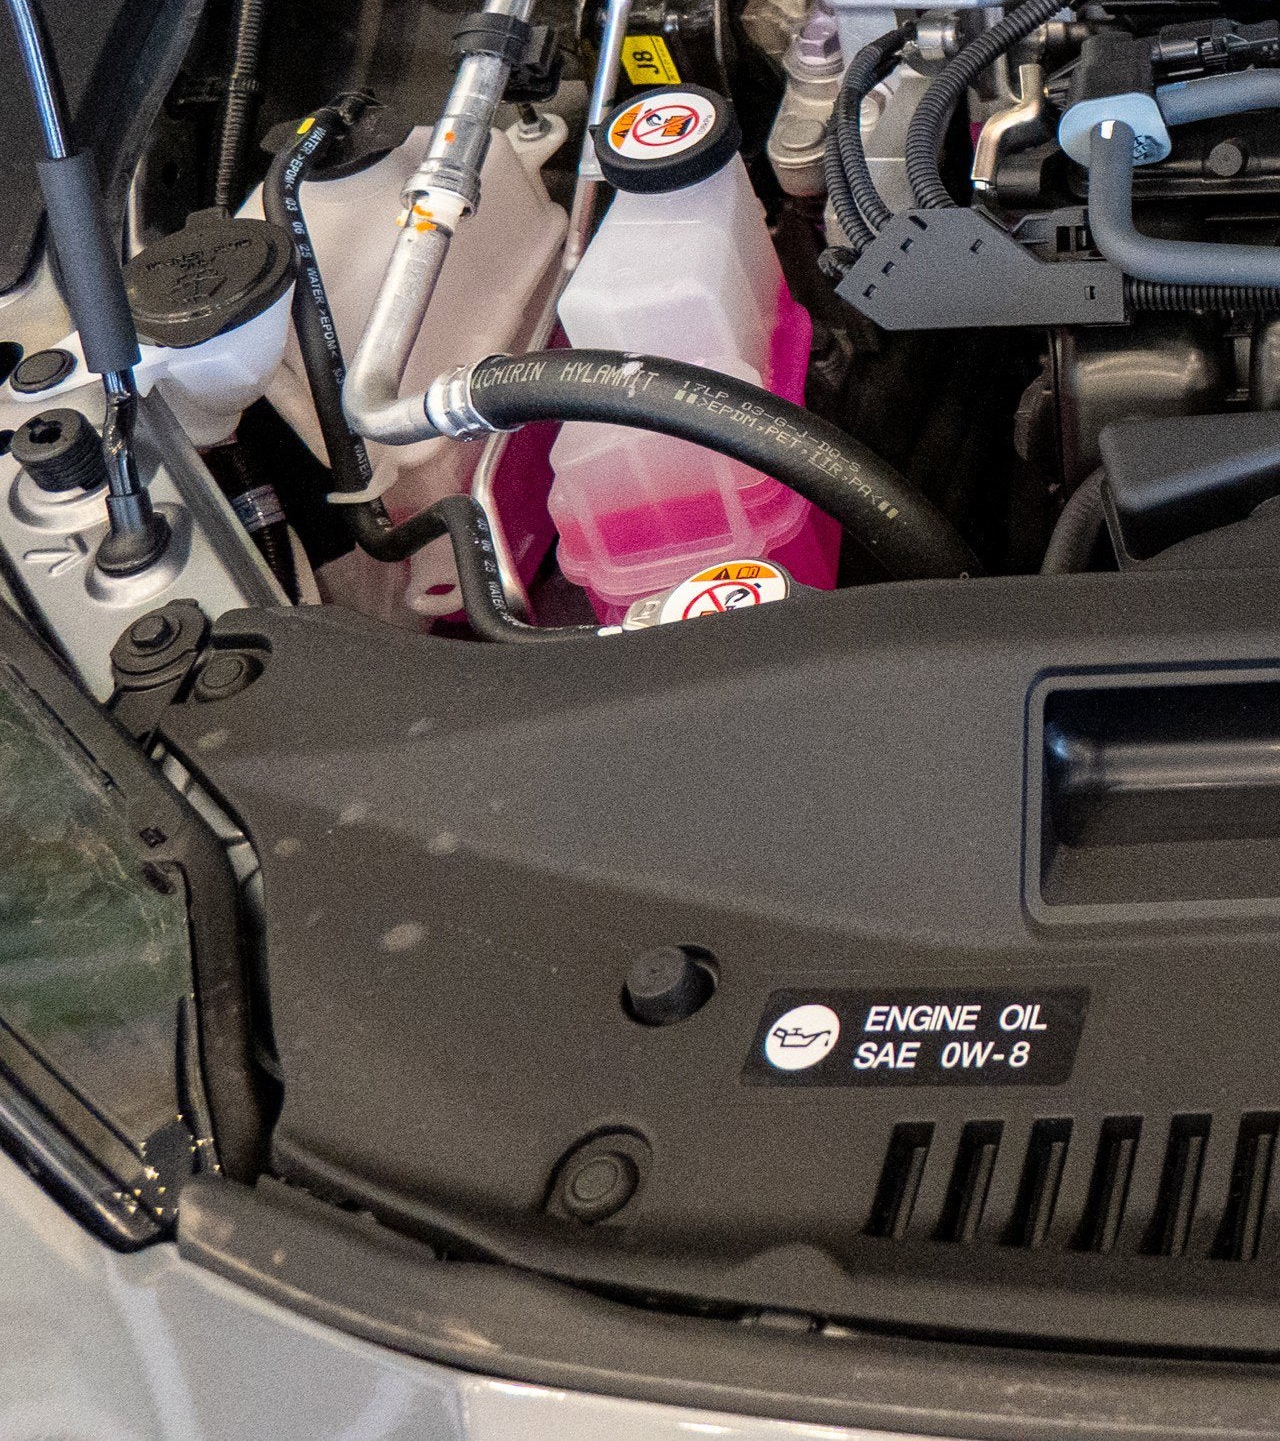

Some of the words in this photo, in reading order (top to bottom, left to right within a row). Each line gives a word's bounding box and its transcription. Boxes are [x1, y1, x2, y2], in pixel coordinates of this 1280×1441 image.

[632, 50, 660, 75] J8
[302, 126, 327, 155] WATER
[292, 221, 305, 235] 06
[300, 243, 313, 259] 25
[307, 267, 325, 305] WATER
[682, 380, 729, 400] 17LP
[484, 559, 496, 573] 25
[489, 580, 507, 610] WATER
[864, 1004, 981, 1031] ENGINE
[999, 1004, 1047, 1031] OIL
[853, 1042, 921, 1069] SAE
[941, 1041, 1030, 1069] 0W-8
